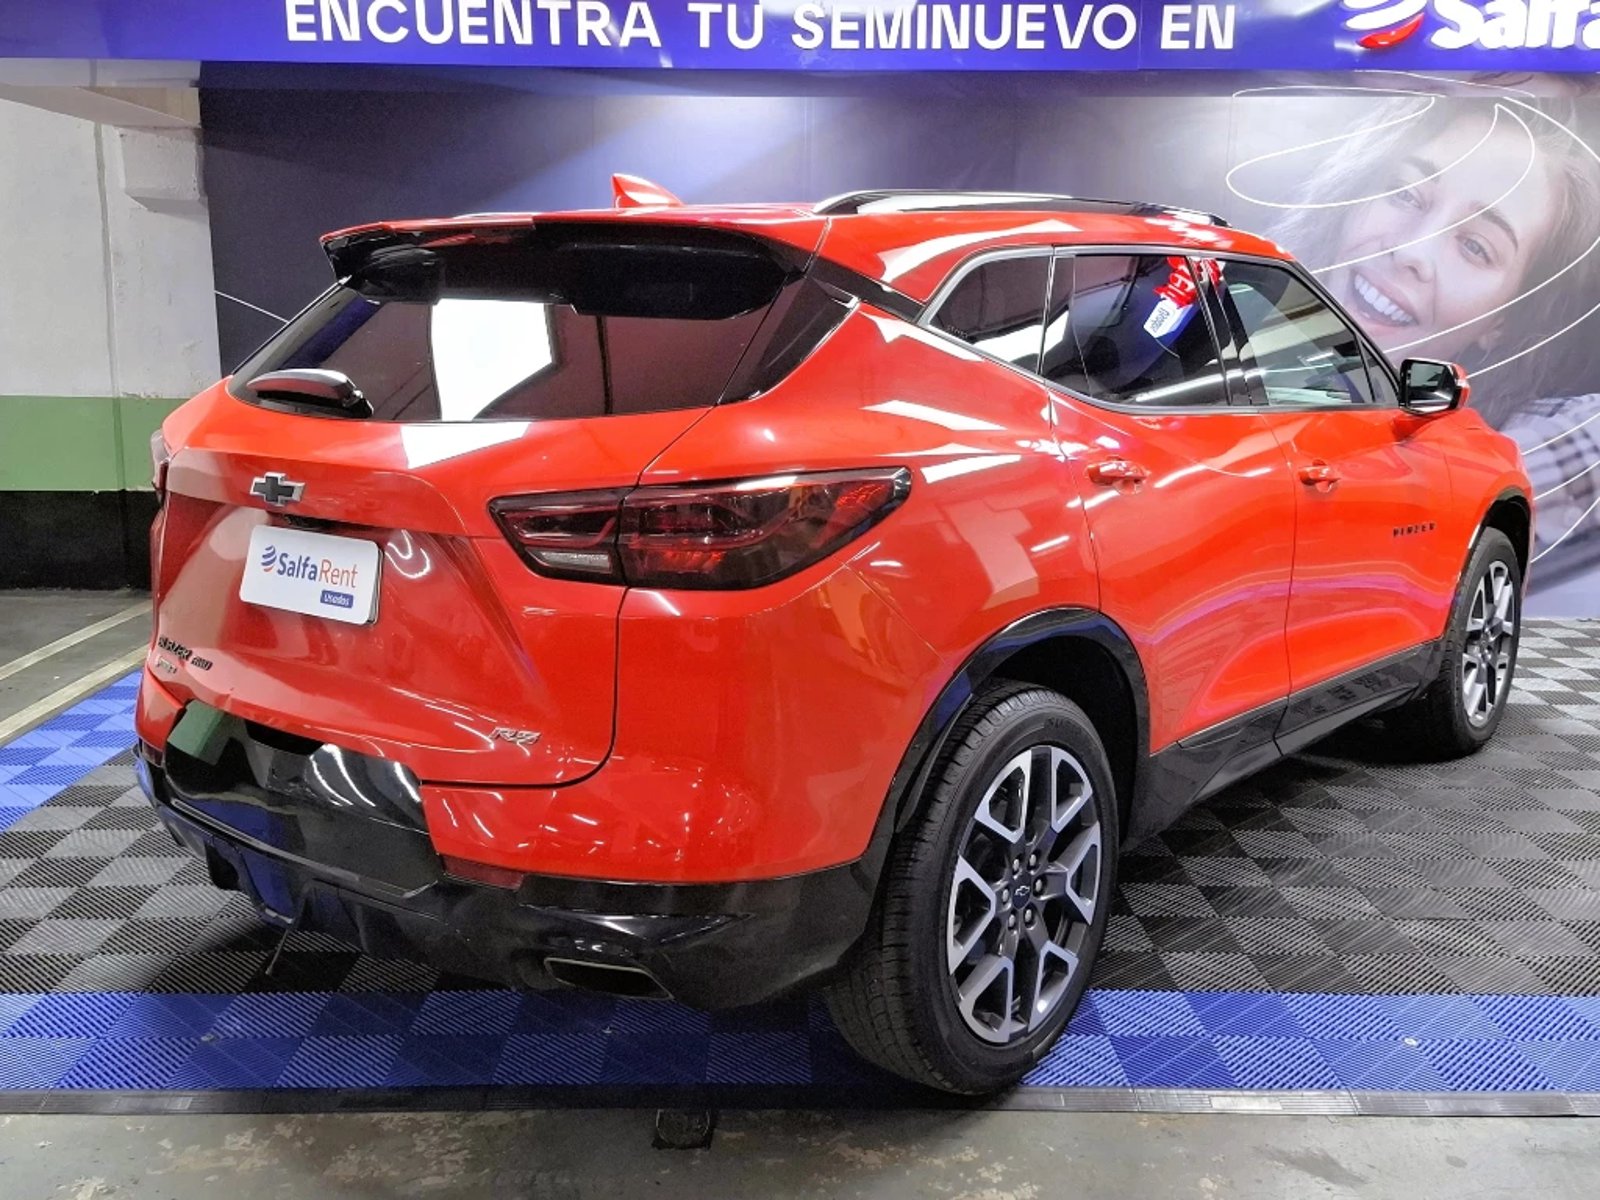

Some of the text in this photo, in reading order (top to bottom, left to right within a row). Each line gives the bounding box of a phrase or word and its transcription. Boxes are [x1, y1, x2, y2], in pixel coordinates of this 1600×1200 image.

[286, 0, 662, 48] ENCUENTRA
[688, 2, 764, 49] TU
[791, 4, 1137, 50] SEMINUEVO
[1160, 4, 1236, 50] EN
[277, 552, 358, 588] SalfaRent
